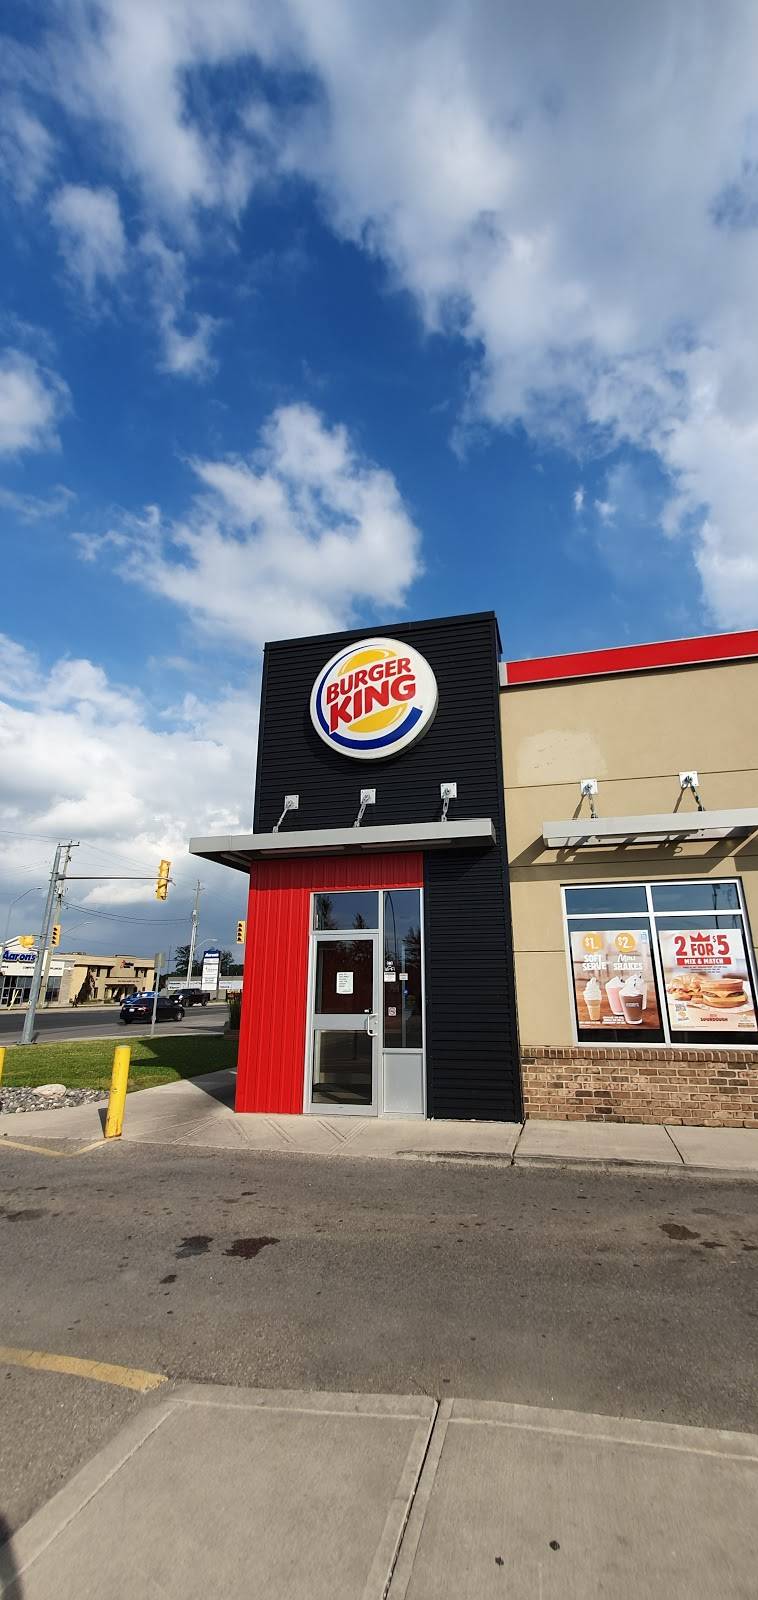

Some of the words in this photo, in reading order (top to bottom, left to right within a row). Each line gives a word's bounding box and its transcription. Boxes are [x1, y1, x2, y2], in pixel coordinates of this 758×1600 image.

[327, 658, 411, 705] BURGER
[330, 674, 416, 732] KING
[674, 935, 687, 956] 2
[690, 943, 715, 956] FOR
[582, 962, 607, 971] SERVE
